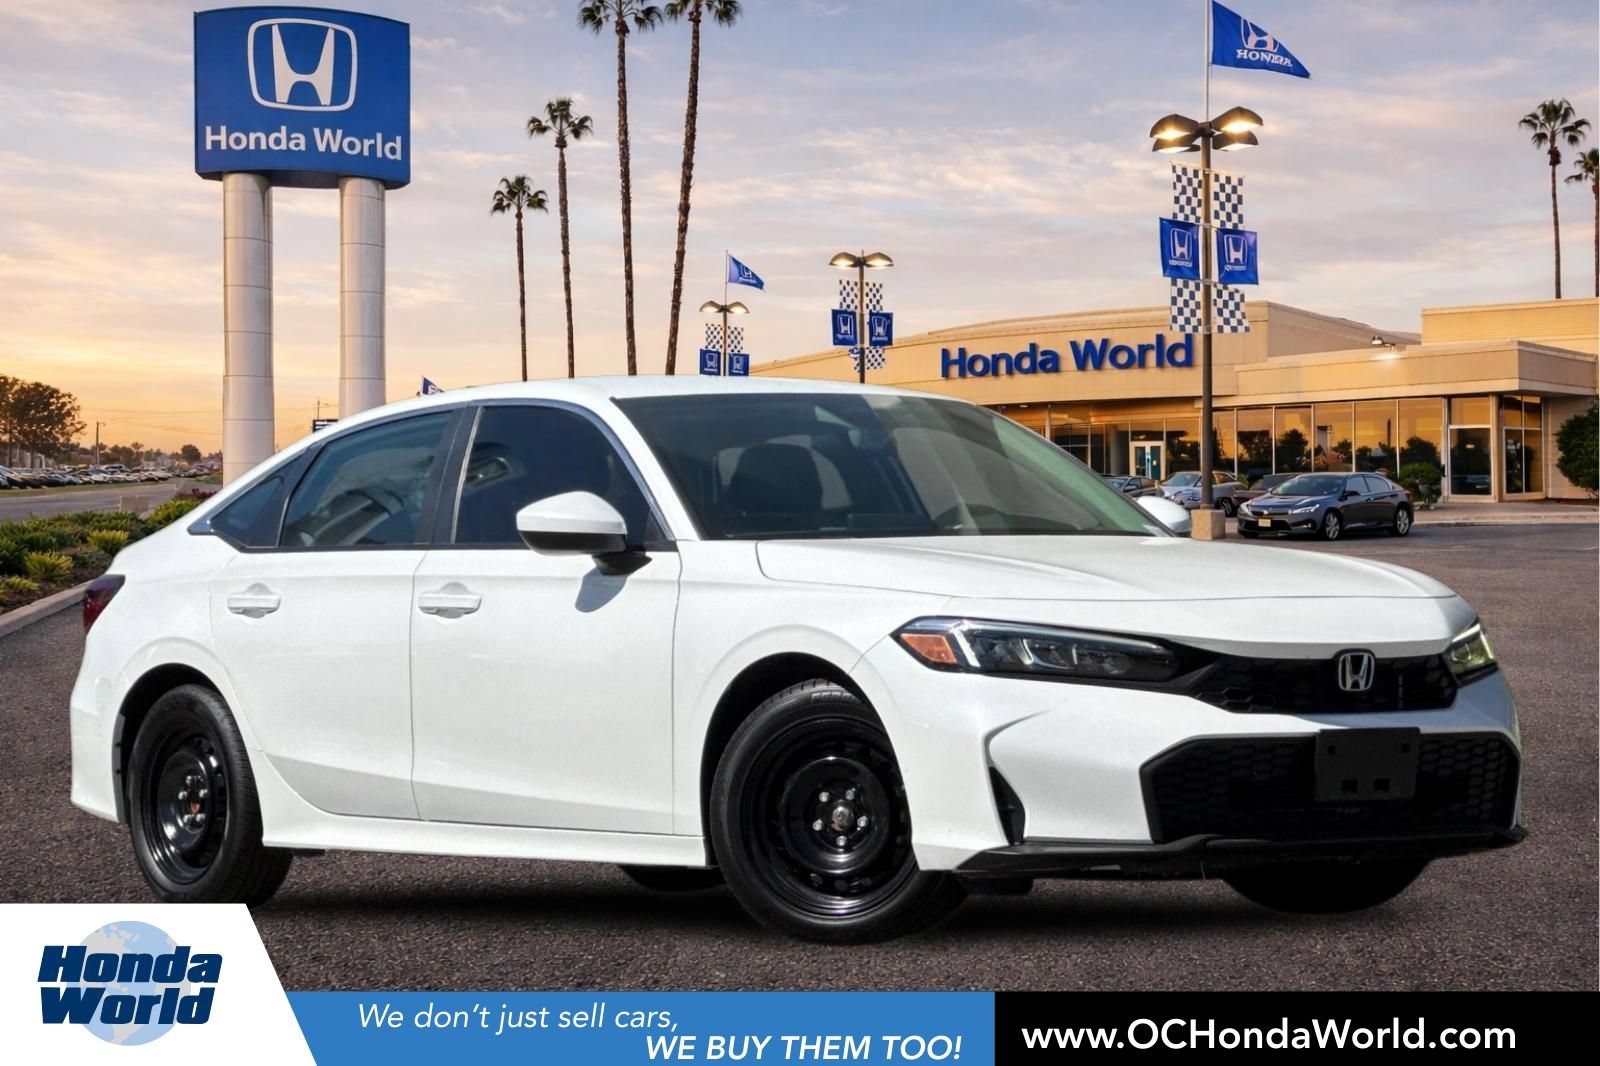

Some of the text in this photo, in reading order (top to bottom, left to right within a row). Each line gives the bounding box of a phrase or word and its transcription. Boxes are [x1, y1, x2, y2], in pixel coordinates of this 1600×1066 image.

[205, 125, 402, 161] Honda World
[941, 333, 1194, 378] Honda World
